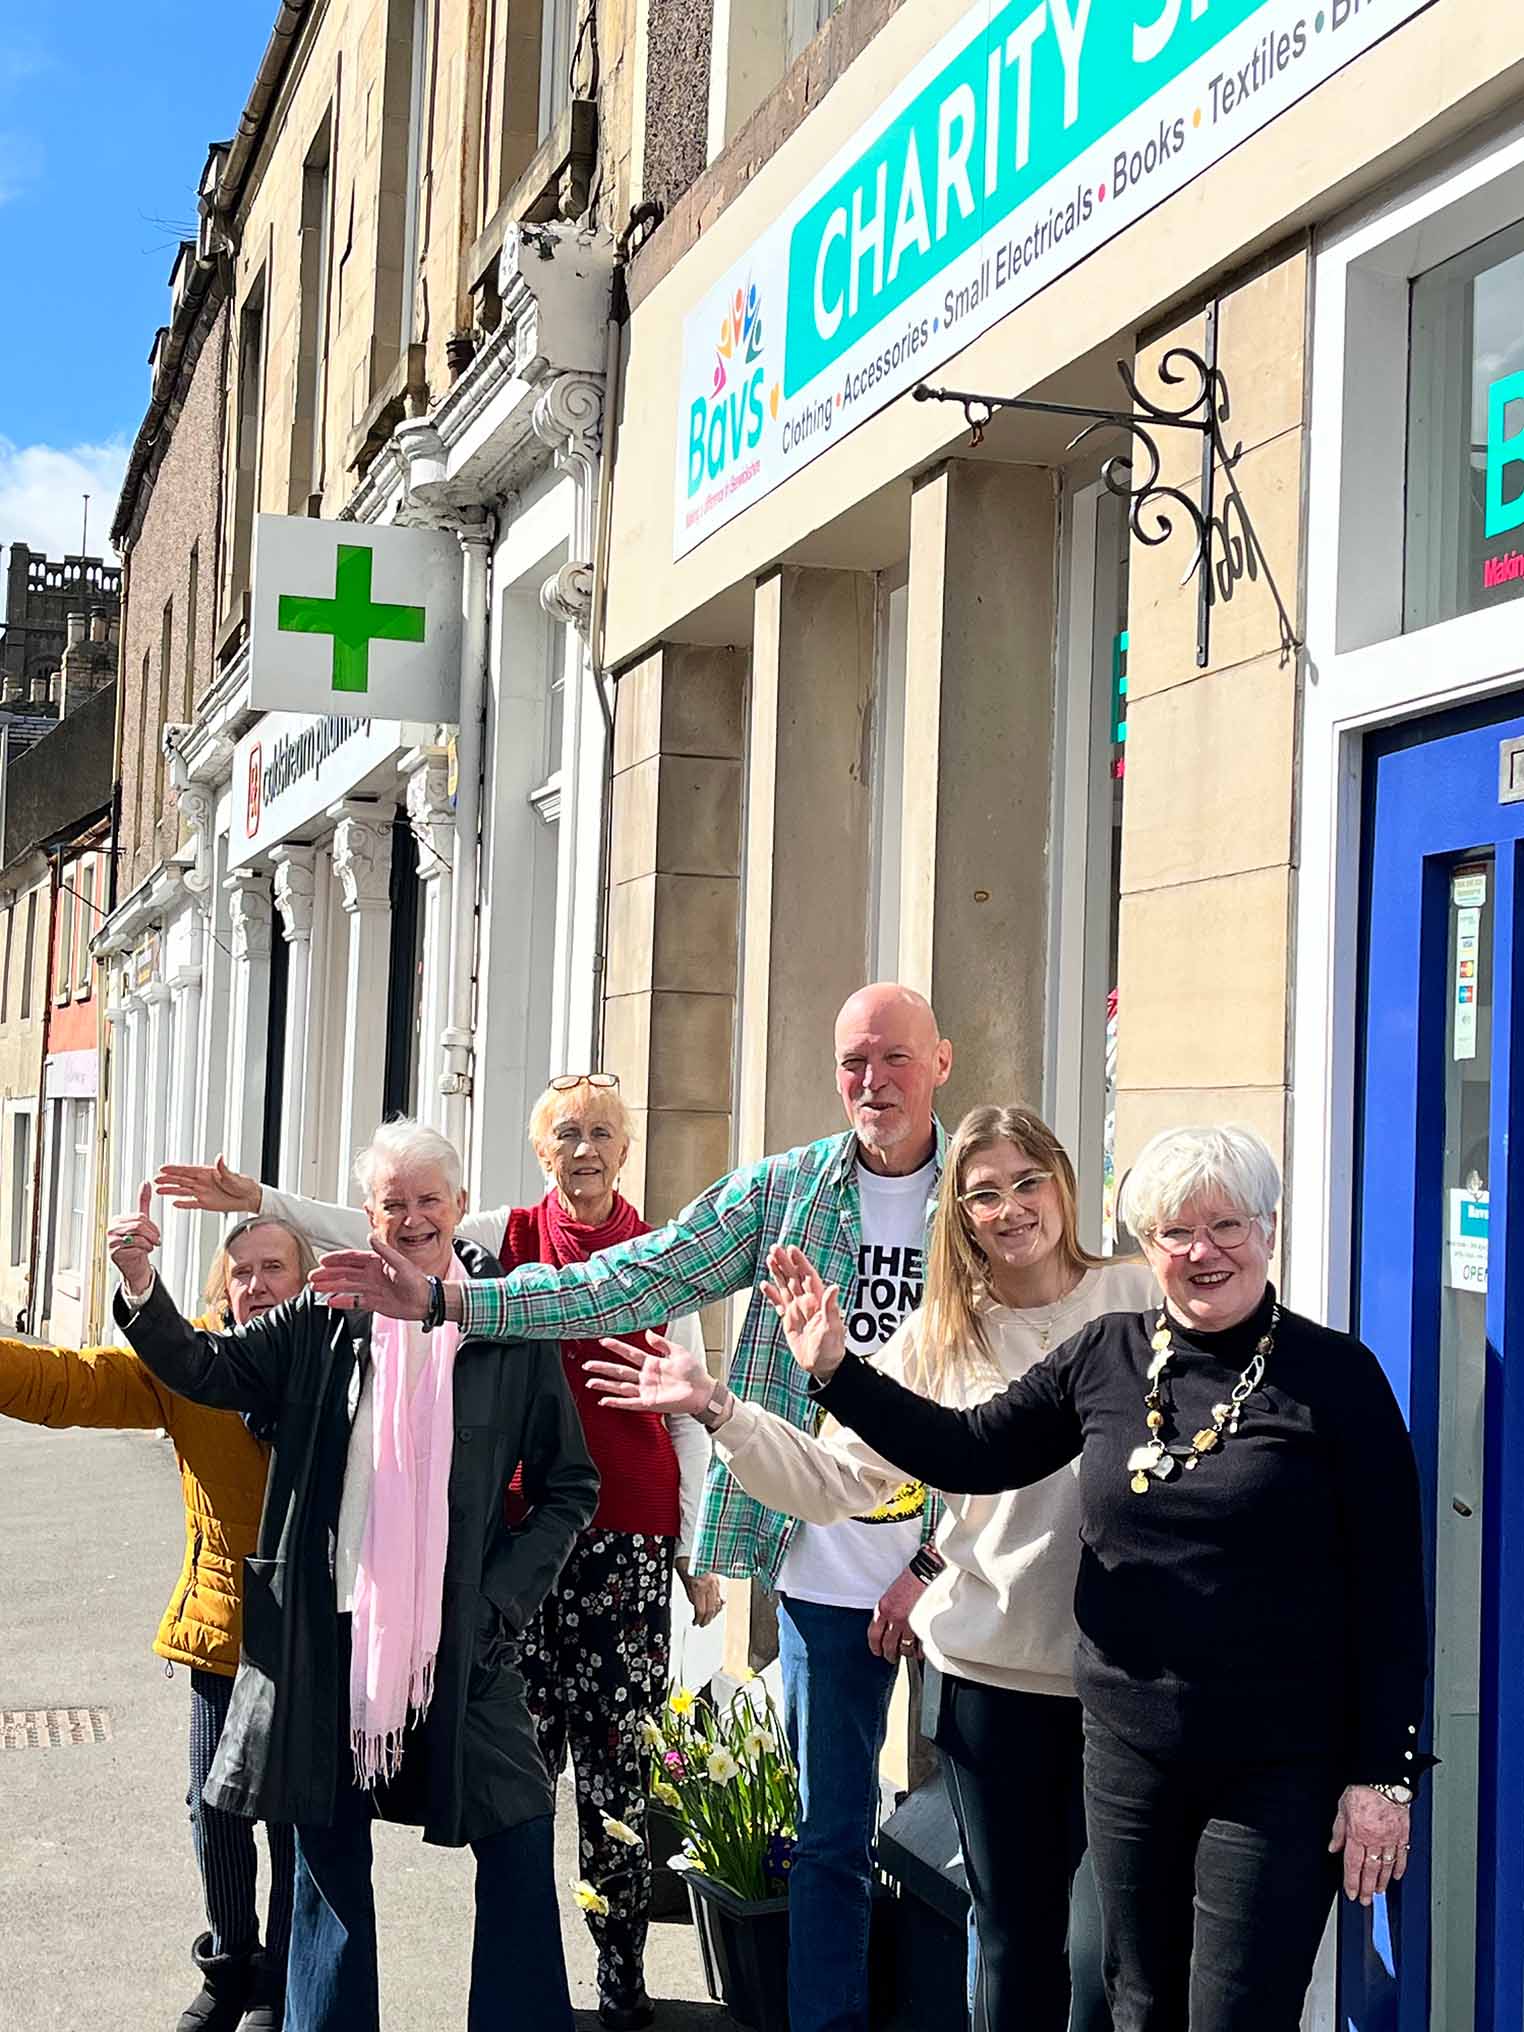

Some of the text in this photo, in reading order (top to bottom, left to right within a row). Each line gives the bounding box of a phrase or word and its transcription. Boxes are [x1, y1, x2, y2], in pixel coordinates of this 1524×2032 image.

[813, 0, 1091, 341] CHARITY
[782, 396, 832, 454] Clothing
[842, 317, 928, 410] Accessories
[943, 258, 990, 329] Small
[995, 183, 1093, 290] Electricals
[1112, 117, 1185, 200] Books
[1208, 18, 1306, 125] Textiles
[687, 366, 764, 499] Bavs
[1483, 550, 1524, 588] Makin
[857, 1244, 923, 1279] THE
[848, 1311, 907, 1344] OS
